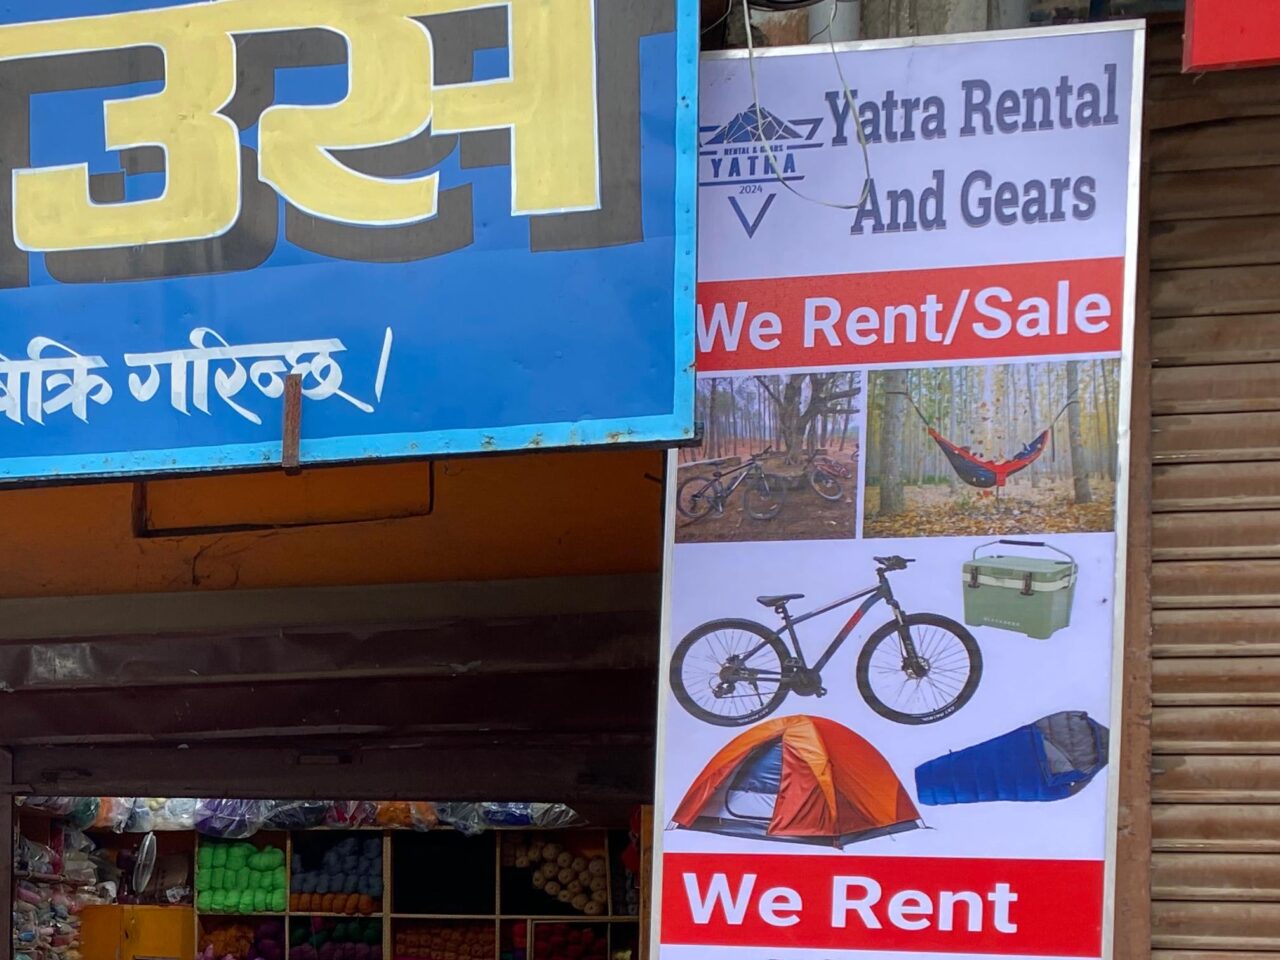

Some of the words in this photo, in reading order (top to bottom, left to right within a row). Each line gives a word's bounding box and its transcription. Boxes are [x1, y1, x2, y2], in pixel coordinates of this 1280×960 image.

[825, 88, 947, 147] Yatra
[960, 63, 1120, 138] Rental
[711, 153, 796, 178] YATRA
[739, 185, 763, 195] 2024
[850, 168, 948, 236] And
[960, 169, 1097, 229] Gears
[697, 301, 783, 354] We
[803, 279, 1112, 349] Rent/Sale
[683, 873, 803, 927] We
[831, 875, 1018, 934] Rent
